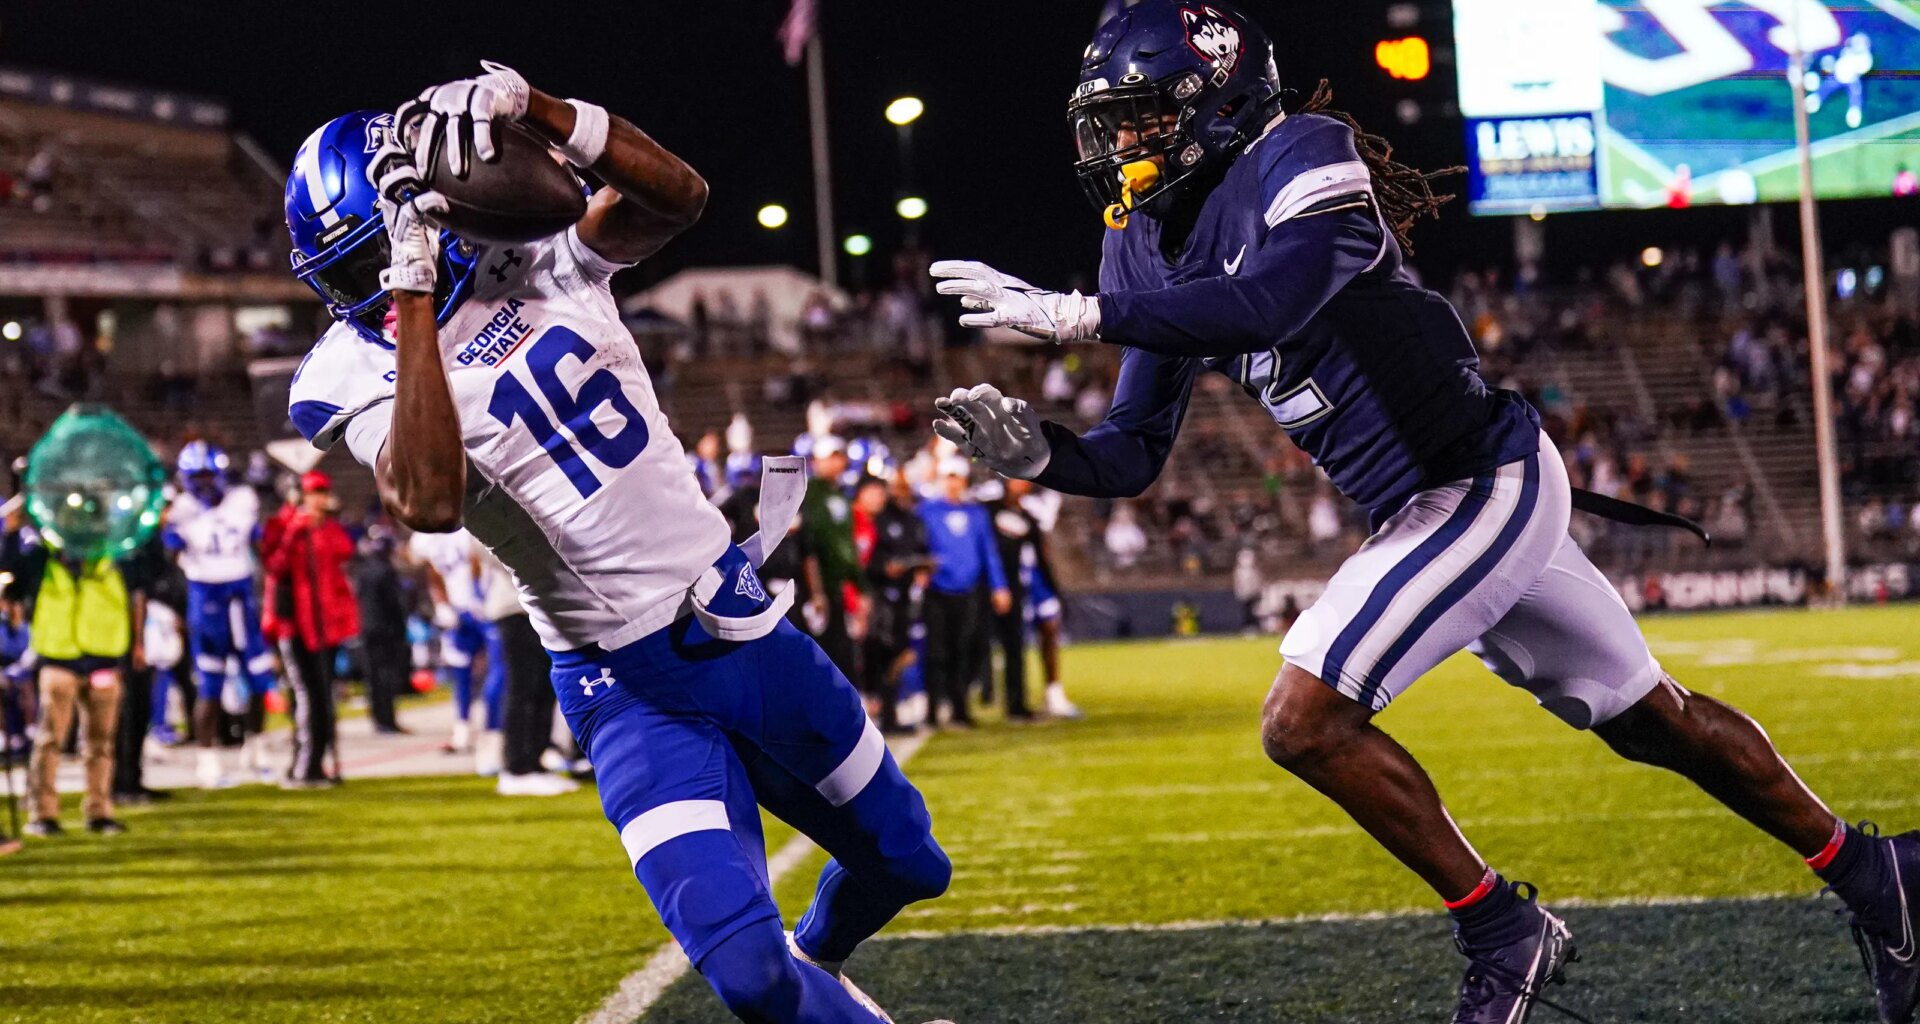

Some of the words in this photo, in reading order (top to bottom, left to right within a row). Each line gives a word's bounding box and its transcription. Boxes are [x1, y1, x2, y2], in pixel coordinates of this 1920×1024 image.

[456, 297, 526, 366] GEORGIA
[480, 316, 530, 366] STATE
[487, 325, 650, 500] 16
